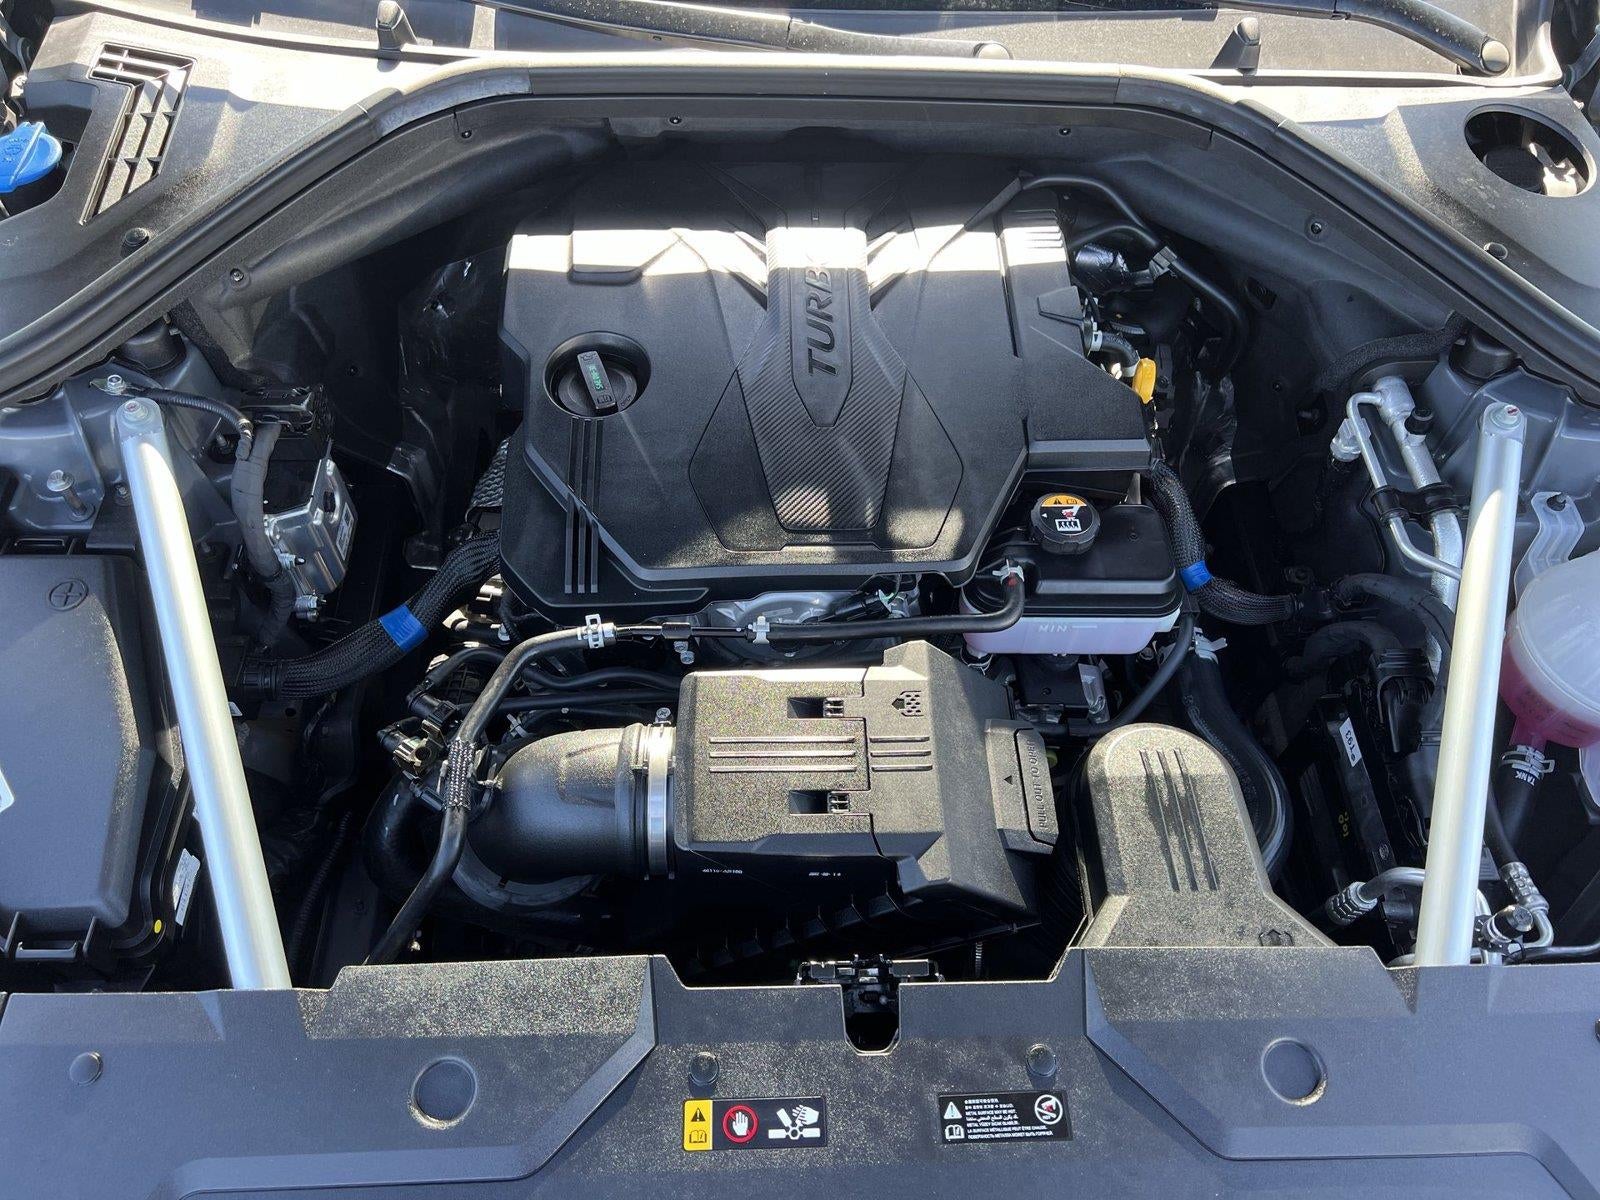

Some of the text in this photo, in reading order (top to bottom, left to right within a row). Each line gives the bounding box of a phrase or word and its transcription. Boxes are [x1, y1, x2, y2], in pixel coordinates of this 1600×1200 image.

[805, 255, 837, 376] TURB
[1031, 766, 1040, 779] TO
[1515, 770, 1535, 786] TANK
[1033, 783, 1043, 802] OUT
[1036, 804, 1048, 829] PULL
